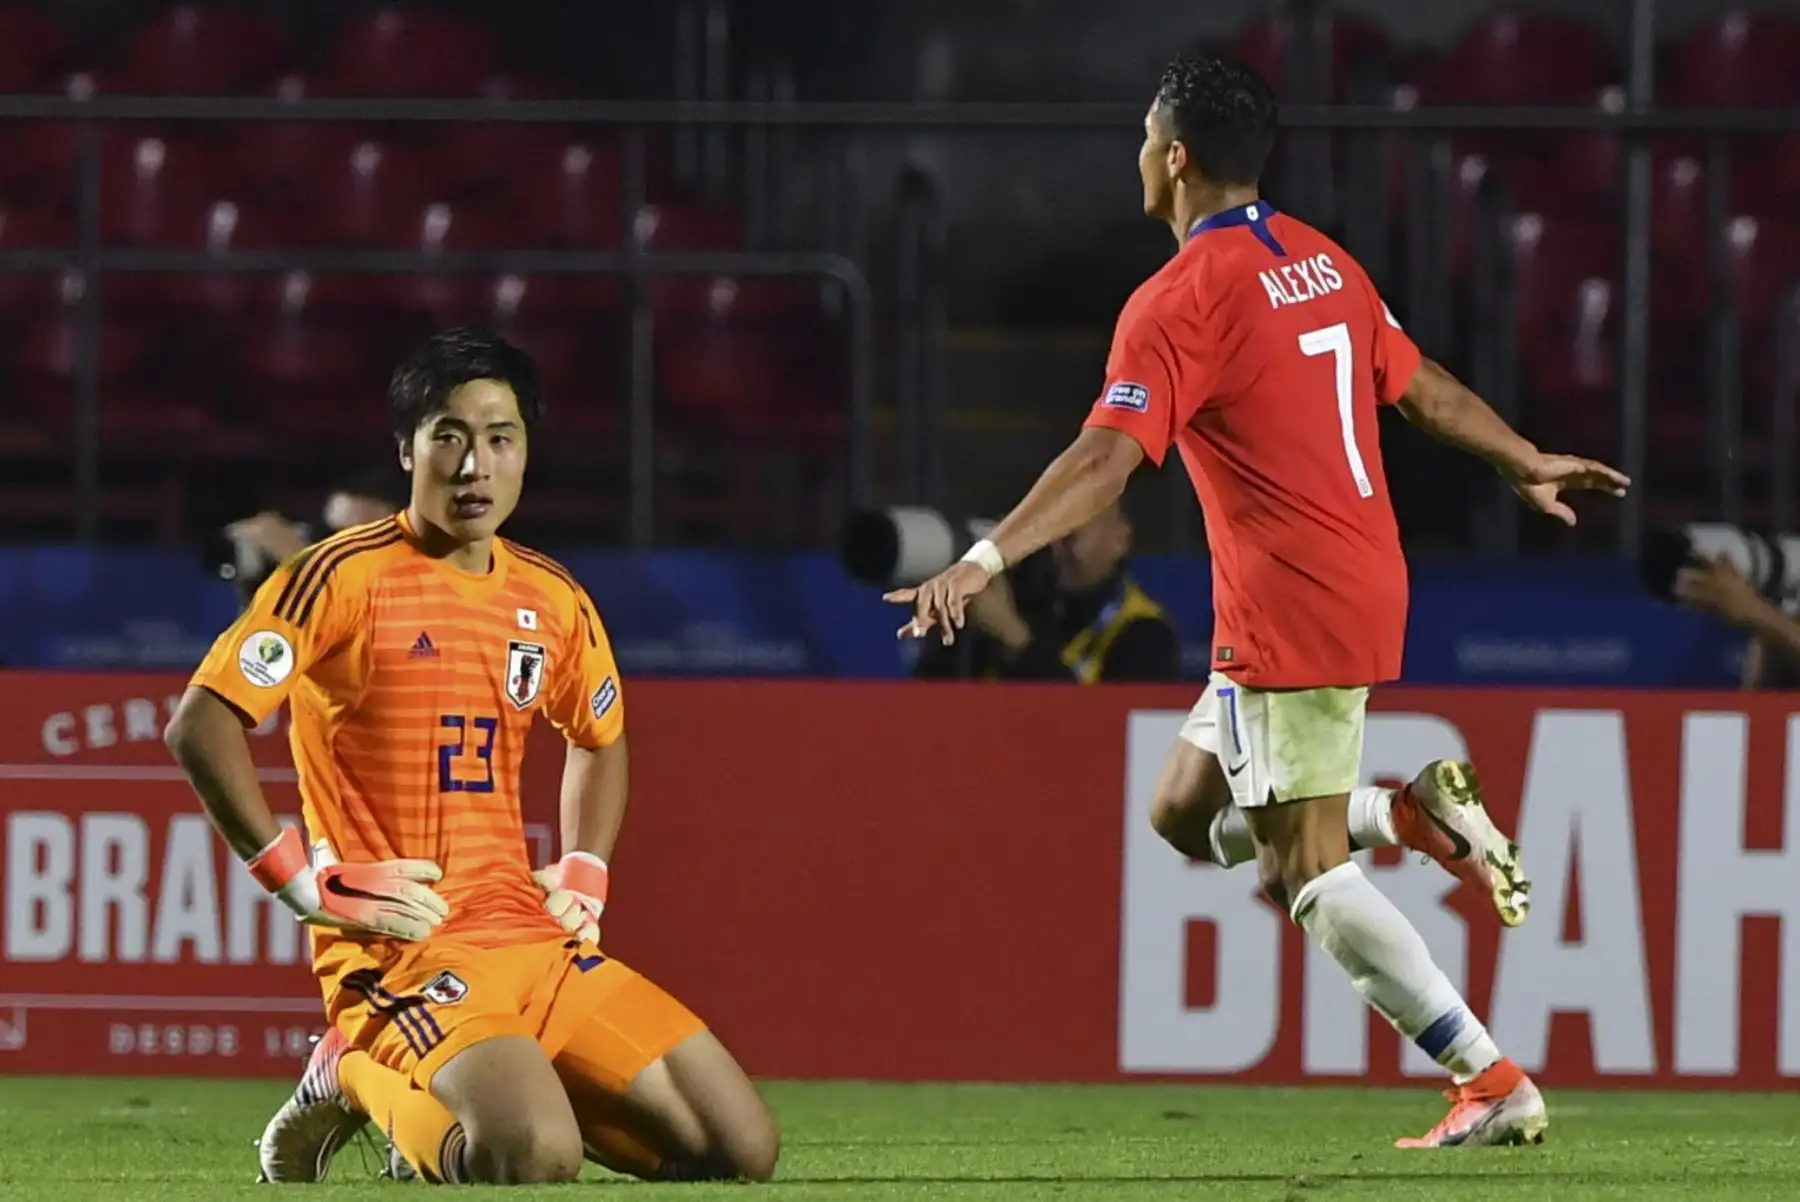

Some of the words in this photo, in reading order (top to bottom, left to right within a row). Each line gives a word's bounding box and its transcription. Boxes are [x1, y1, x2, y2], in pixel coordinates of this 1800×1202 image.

[1258, 253, 1343, 310] ALEXIS
[1297, 322, 1374, 499] 7
[437, 714, 498, 794] 23
[1216, 686, 1242, 755] 7
[5, 811, 312, 964] BRAH
